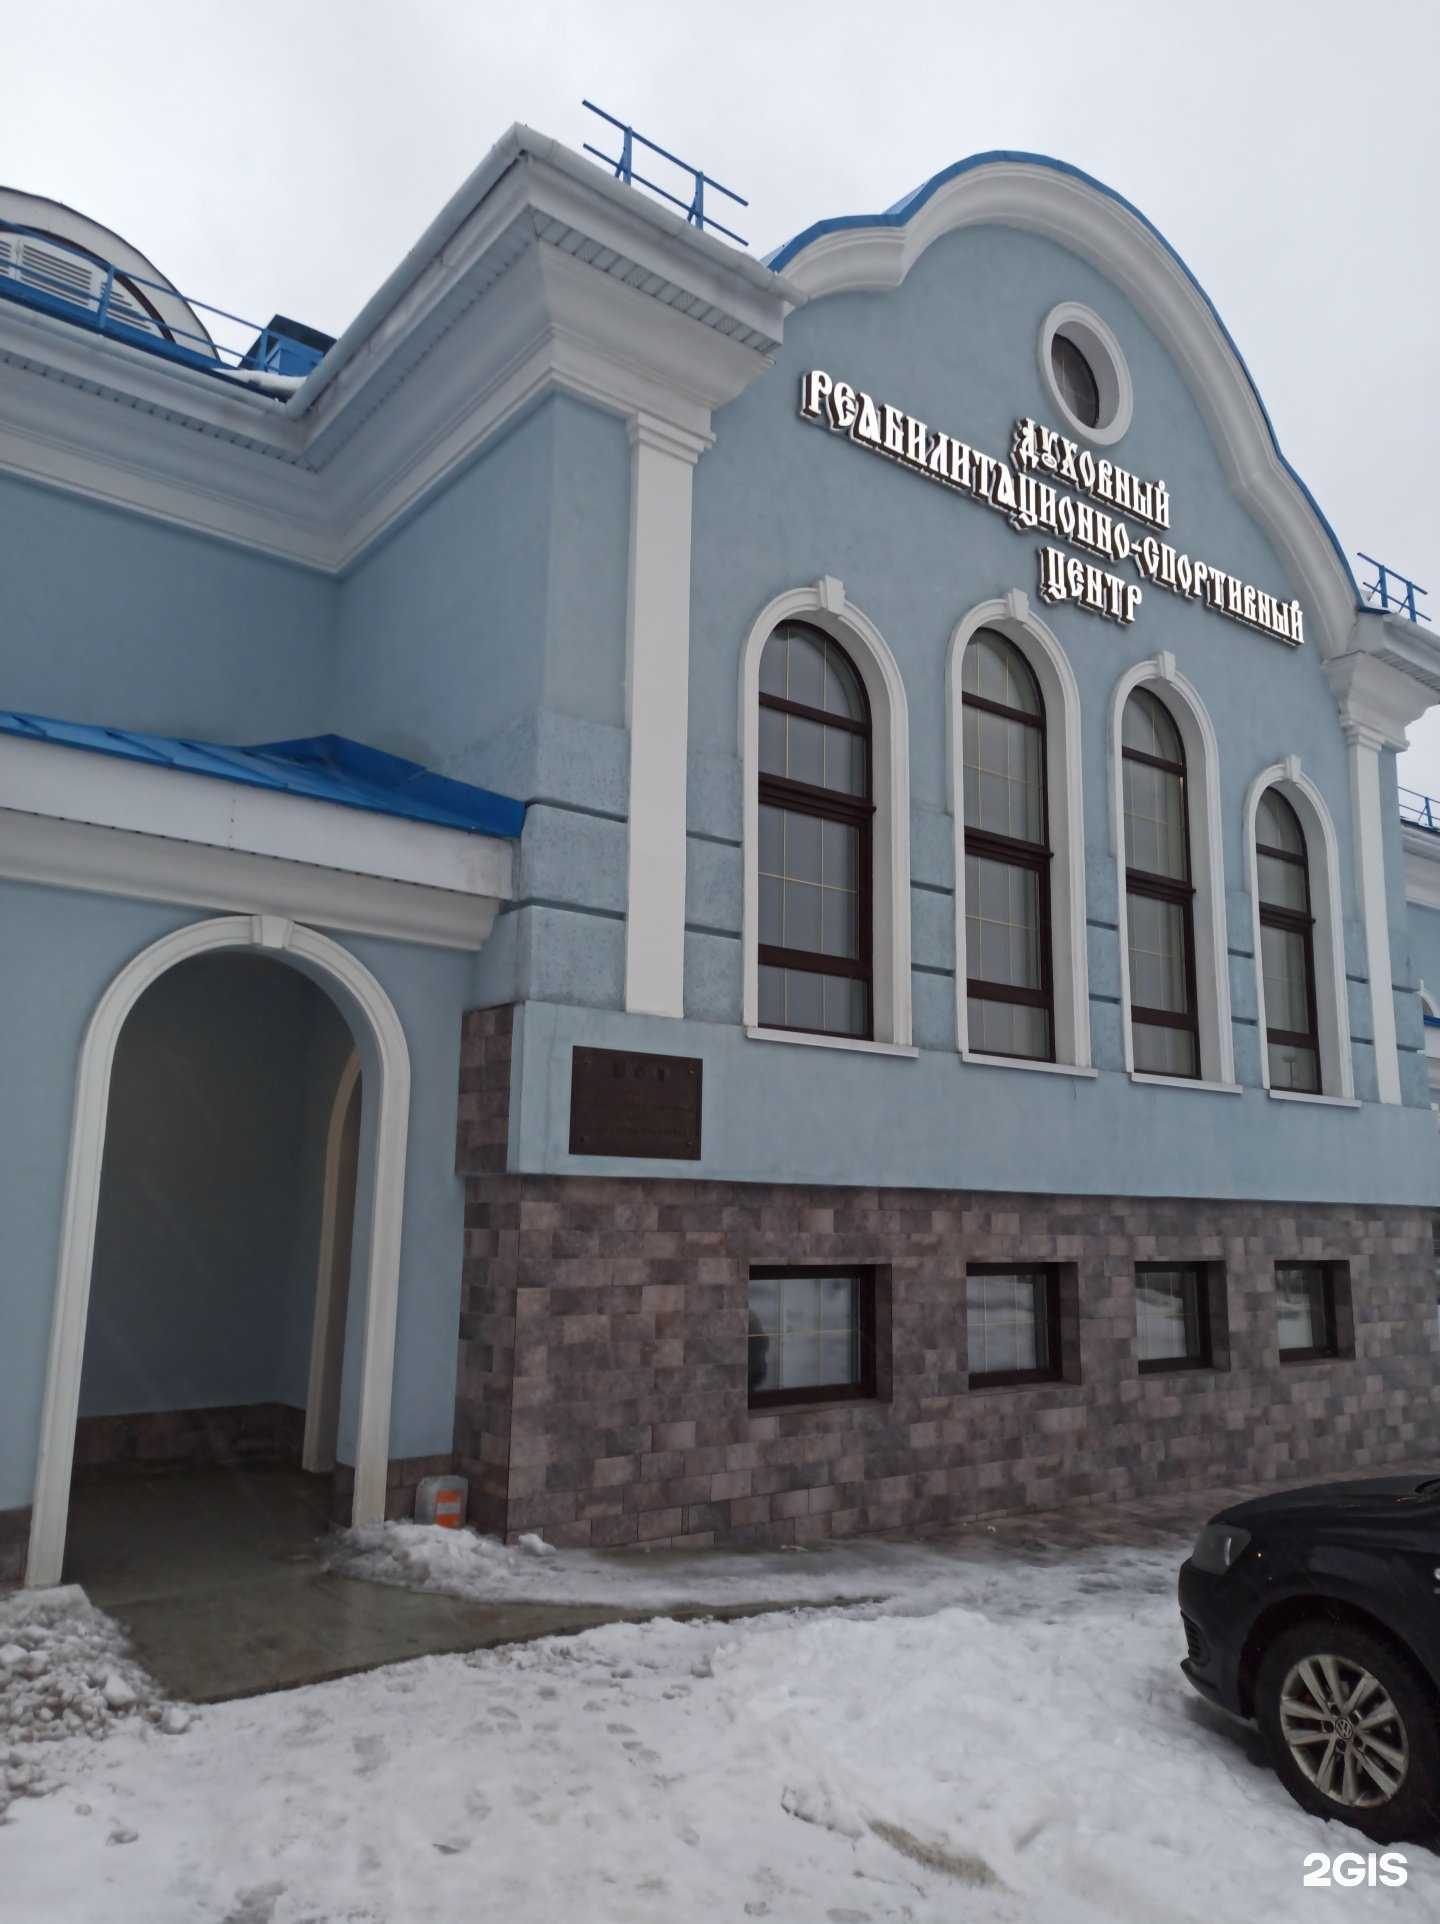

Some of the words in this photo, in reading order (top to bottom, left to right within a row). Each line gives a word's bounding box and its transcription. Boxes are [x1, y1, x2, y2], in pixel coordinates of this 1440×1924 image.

[801, 369, 1305, 646] РЕАБИЛИТАЦИОННО-СПОРТИВНЫЙ
[1014, 417, 1171, 530] ДУХОВНЫЙ
[1041, 546, 1143, 623] ЦЕНТР
